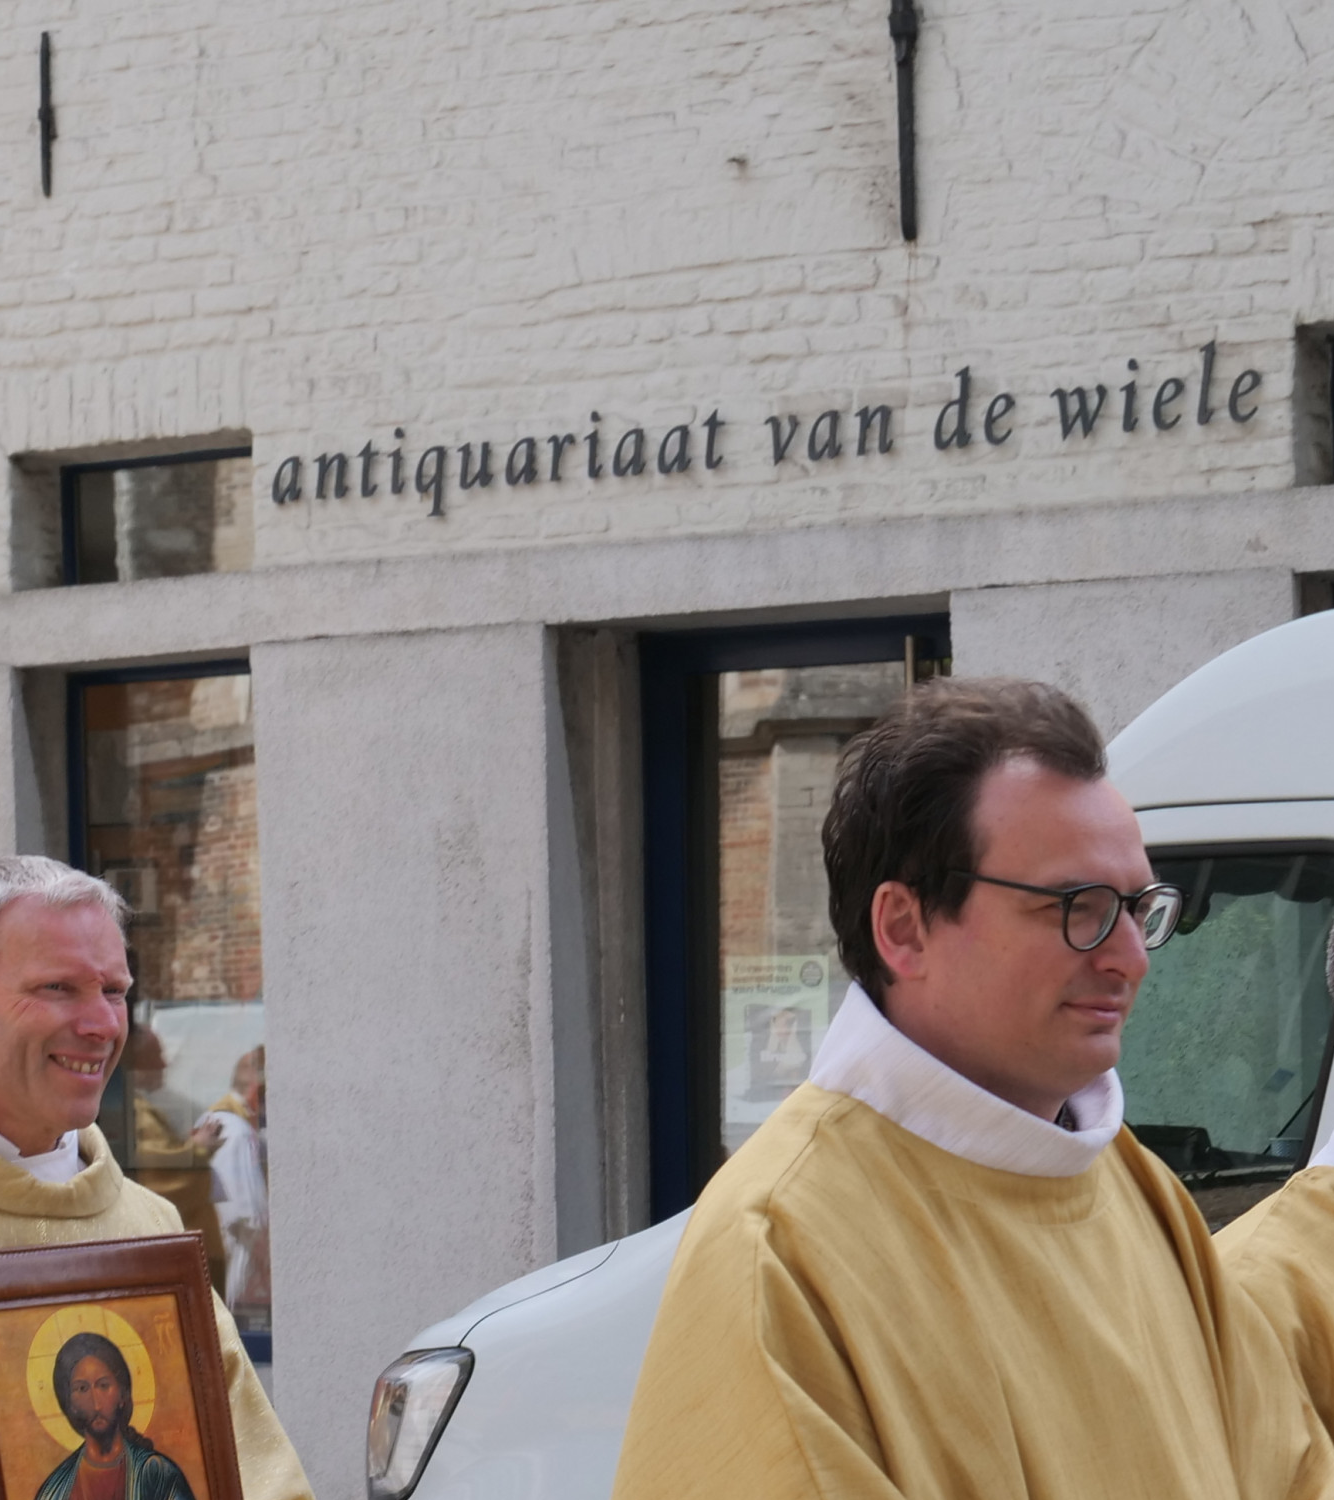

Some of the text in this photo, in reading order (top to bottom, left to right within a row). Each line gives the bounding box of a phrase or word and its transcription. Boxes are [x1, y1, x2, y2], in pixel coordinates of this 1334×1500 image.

[270, 338, 1264, 519] antiquariaat van de wiele
